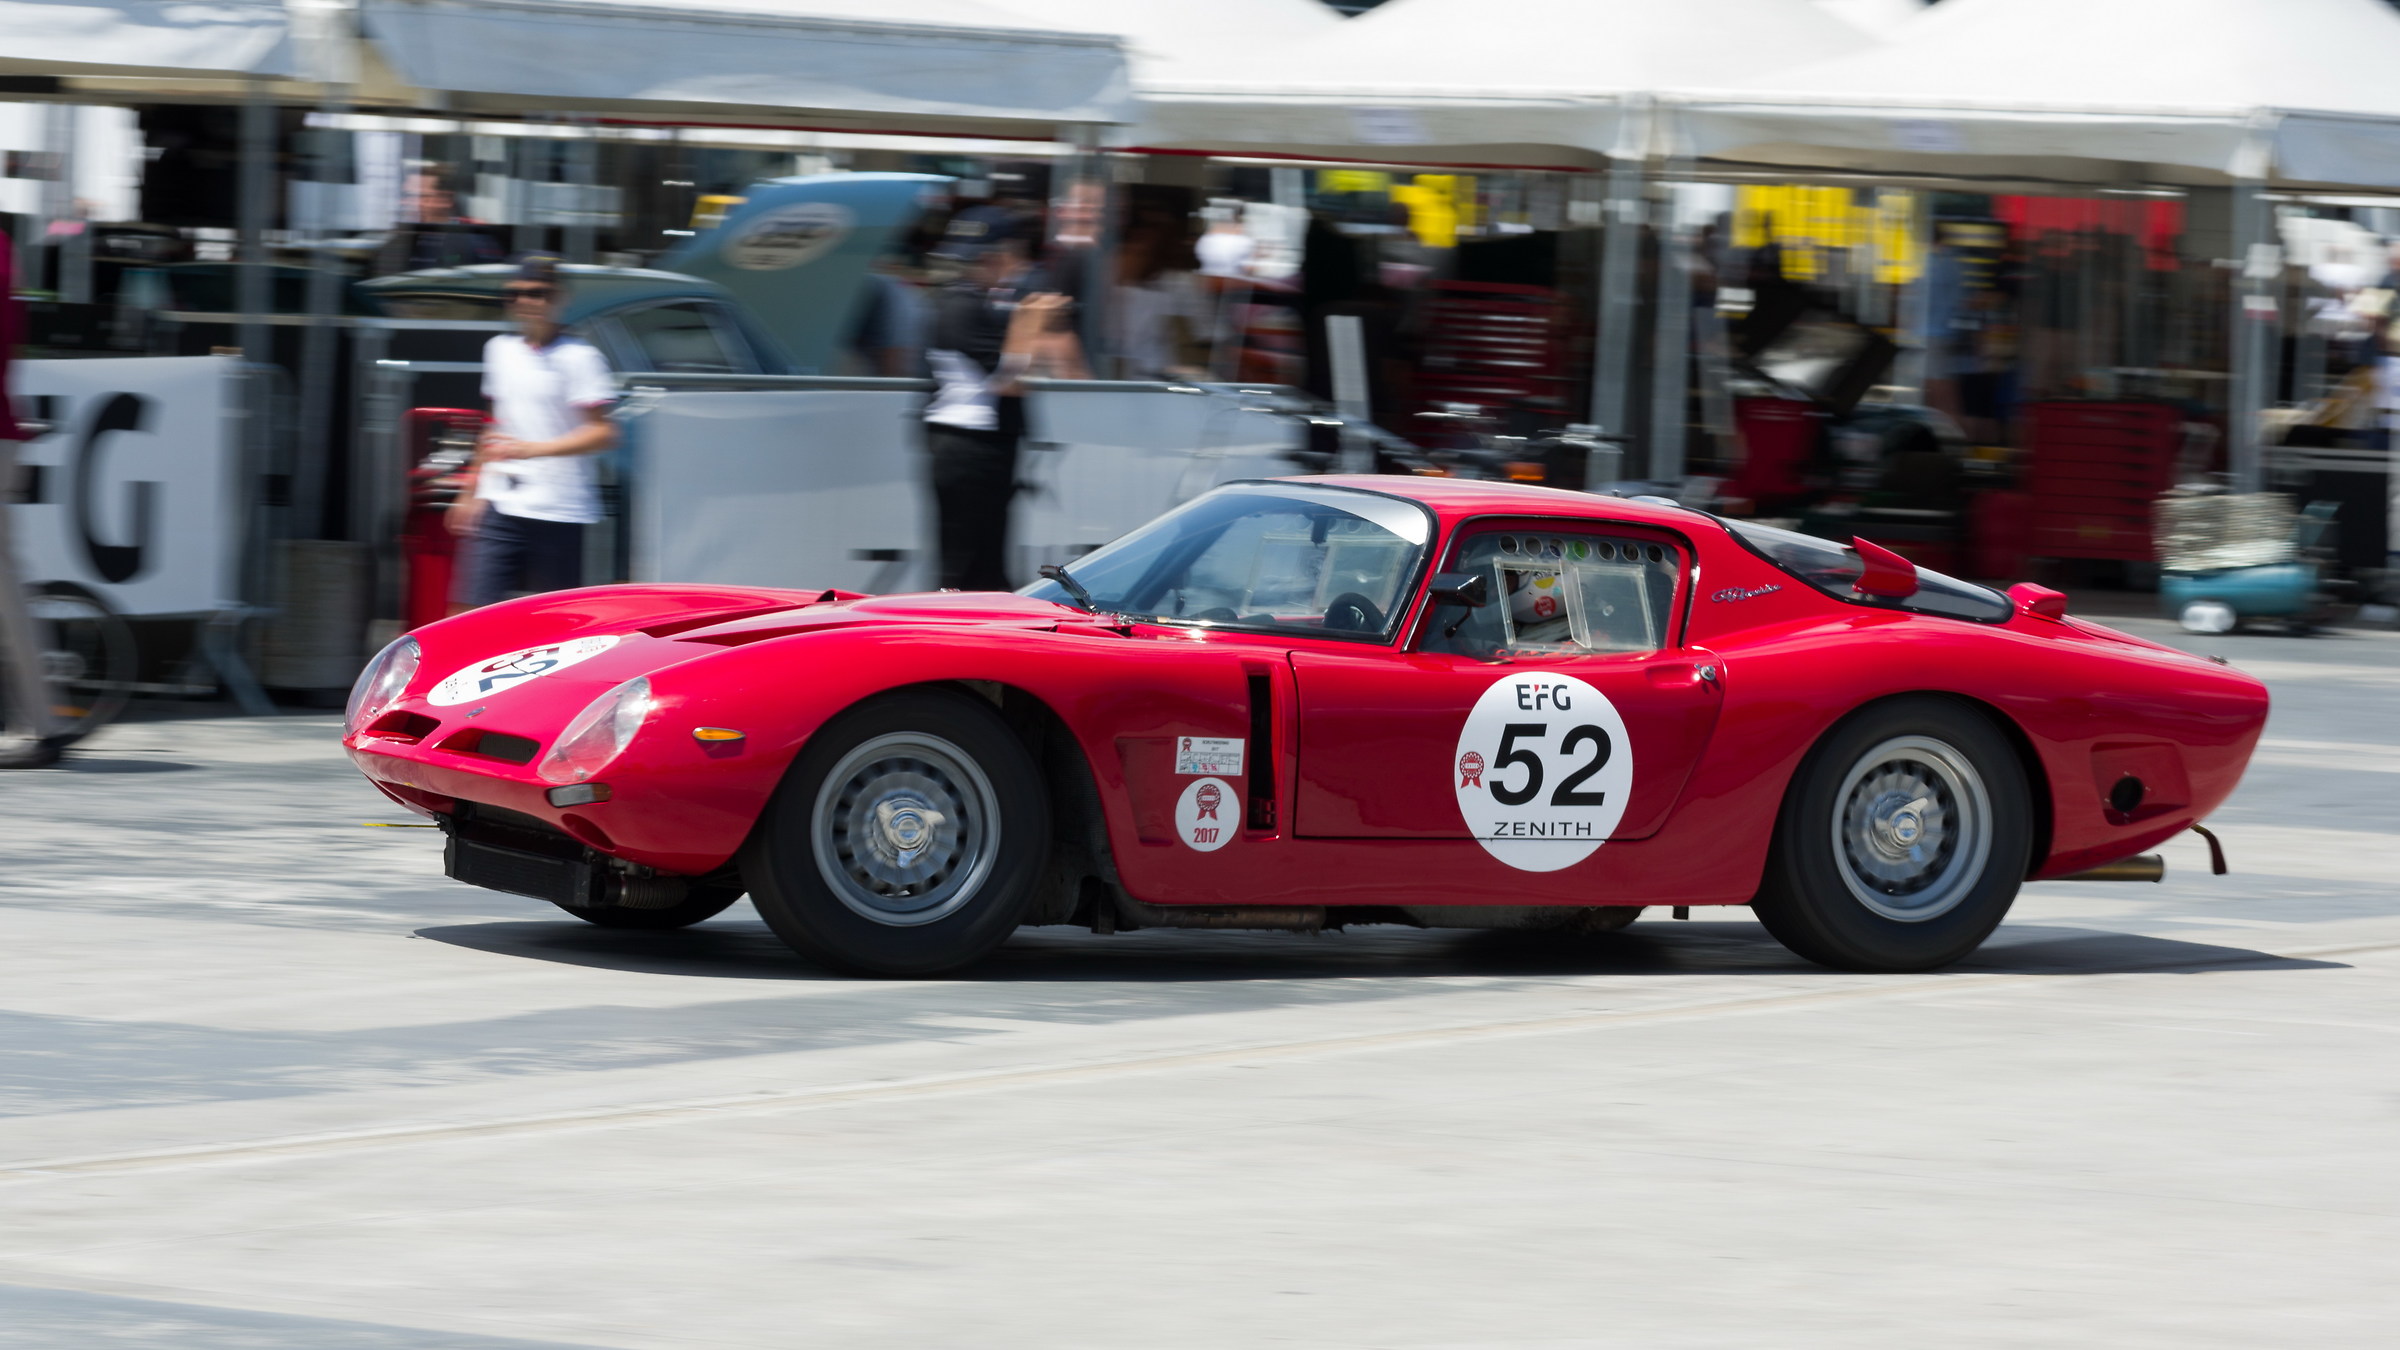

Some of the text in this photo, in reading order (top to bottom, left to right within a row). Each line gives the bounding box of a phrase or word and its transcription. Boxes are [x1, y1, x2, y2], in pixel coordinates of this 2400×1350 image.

[478, 646, 560, 693] 52
[1515, 684, 1571, 711] EFG
[1489, 723, 1612, 806] 52
[1193, 827, 1220, 843] 2017
[1493, 821, 1592, 836] ZENITH
